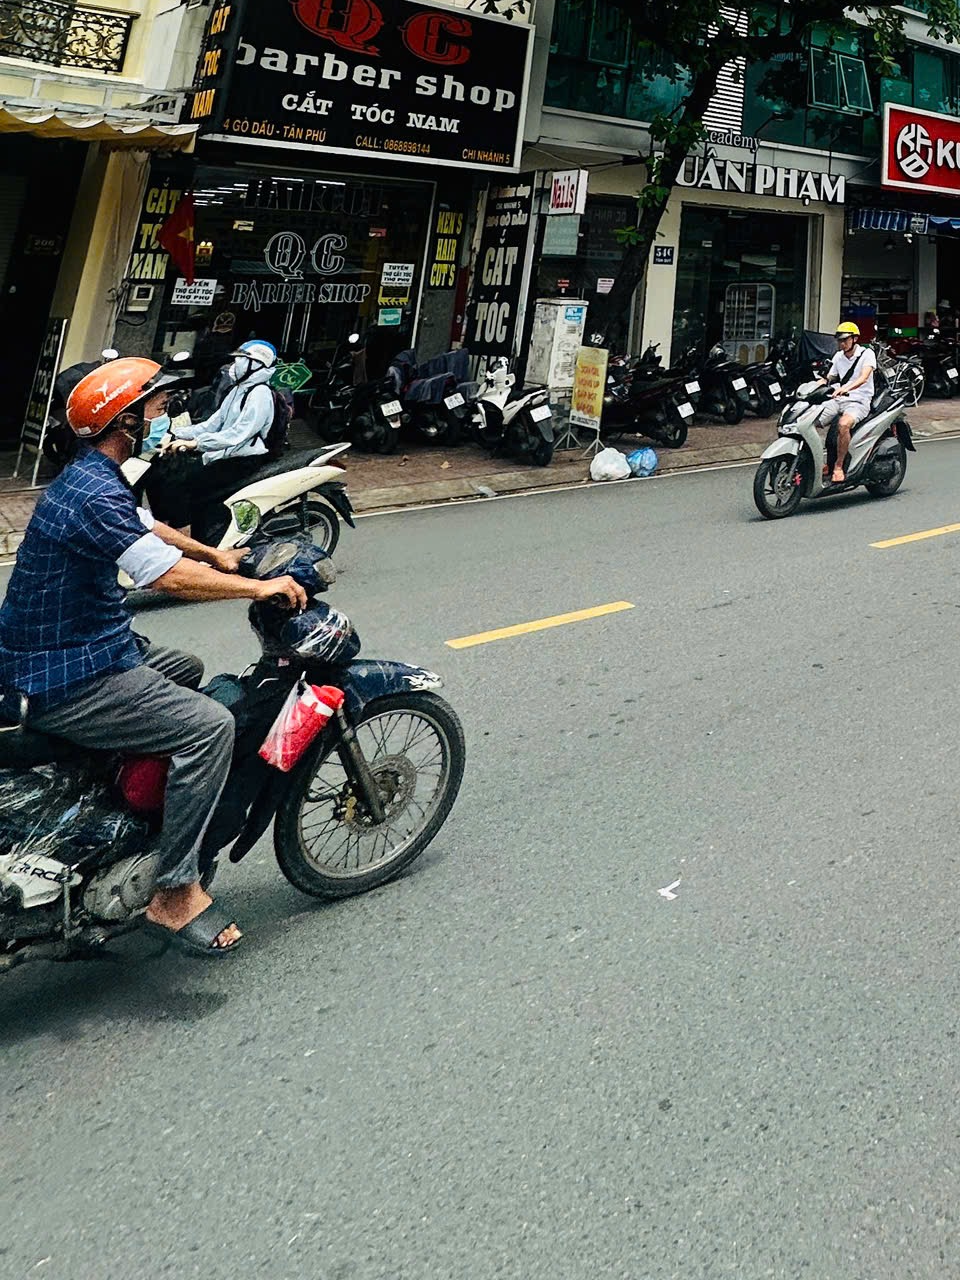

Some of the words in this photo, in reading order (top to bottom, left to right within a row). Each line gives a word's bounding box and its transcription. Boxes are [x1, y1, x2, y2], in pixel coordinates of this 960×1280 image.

[235, 35, 402, 91] barber
[414, 72, 517, 113] shop
[190, 88, 216, 119] NAM
[280, 90, 333, 117] CẮT
[350, 103, 395, 125] TÓC
[406, 112, 460, 135] NAM
[232, 116, 250, 133] GÒ
[282, 123, 305, 141] TÂN
[304, 127, 328, 143] PHÚ
[355, 135, 383, 150] CALL:
[462, 147, 477, 161] CHI
[476, 149, 506, 164] NHÁNH
[504, 153, 511, 165] 5
[551, 175, 576, 209] Nails
[140, 217, 167, 250] TÓ
[436, 211, 464, 235] MEN'S
[435, 238, 457, 262] HAIR
[482, 228, 519, 286] CẮT
[129, 252, 170, 280] NAM
[430, 262, 456, 287] CUT'S
[317, 283, 372, 304] SHOP
[474, 291, 512, 344] TÓC
